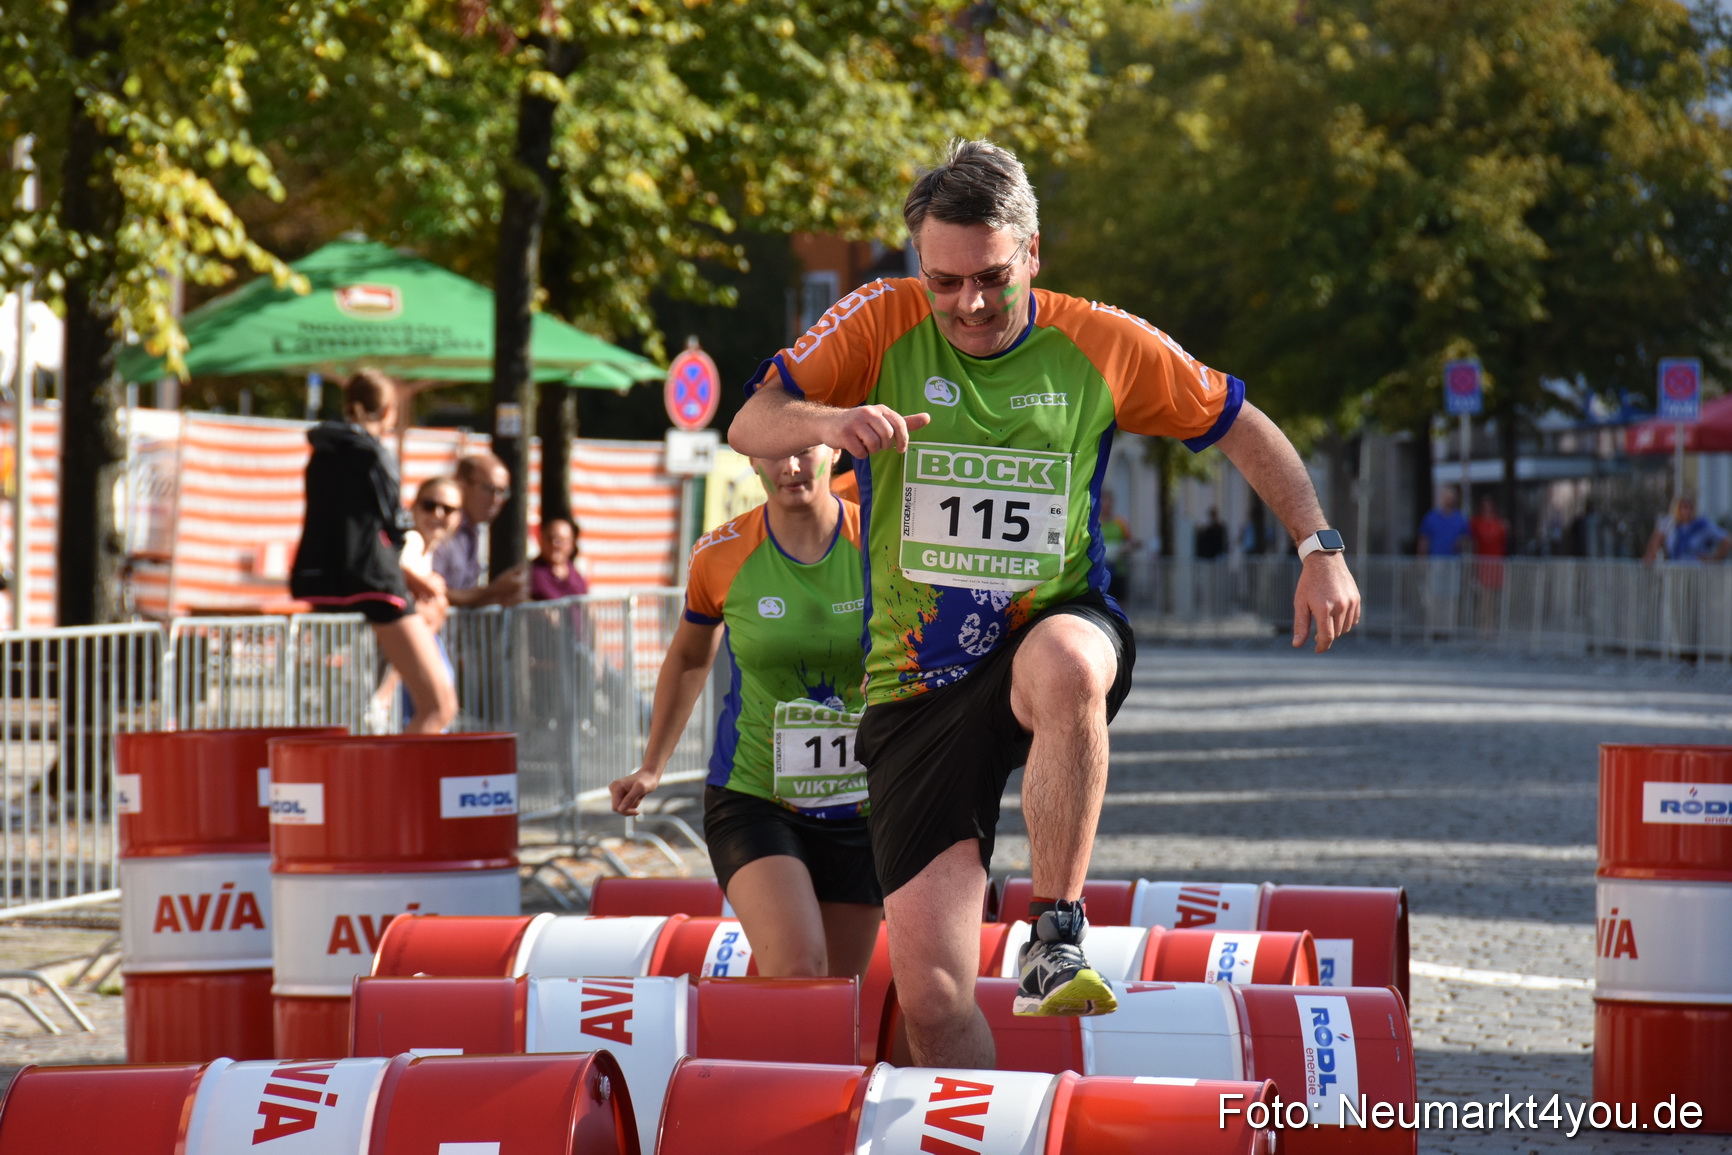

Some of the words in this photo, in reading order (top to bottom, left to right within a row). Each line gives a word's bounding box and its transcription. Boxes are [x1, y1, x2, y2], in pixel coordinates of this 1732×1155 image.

[1010, 392, 1068, 409] BOCK
[917, 449, 1055, 489] BOCK
[939, 496, 1031, 542] 115
[1050, 507, 1062, 515] E6
[921, 549, 1041, 577] GUNTHER
[831, 598, 865, 614] BOC
[805, 734, 848, 769] 11
